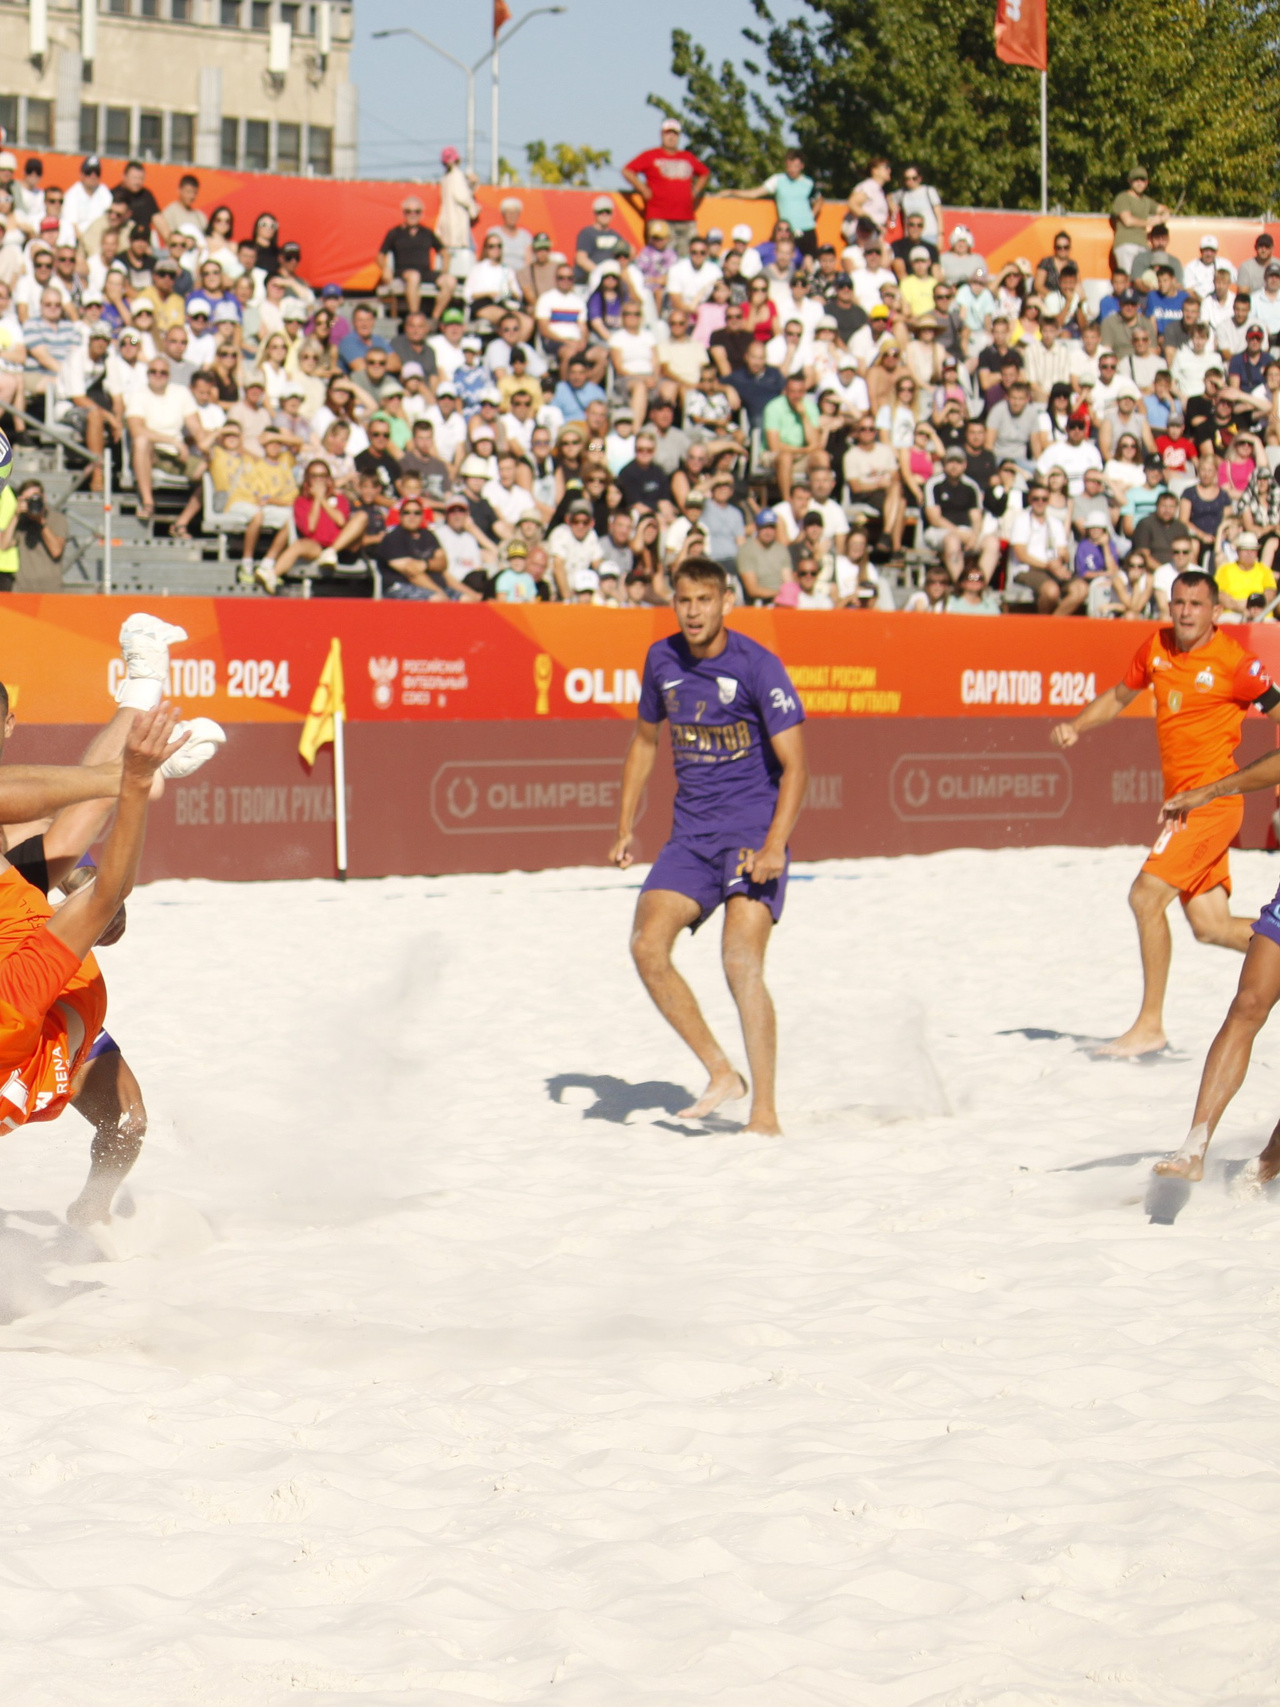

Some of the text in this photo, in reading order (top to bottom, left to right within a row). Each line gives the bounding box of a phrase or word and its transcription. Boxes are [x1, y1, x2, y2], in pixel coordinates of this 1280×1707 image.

[227, 660, 291, 698] 2024
[961, 669, 1096, 705] САРАТОВ 2024
[176, 781, 210, 826] ВСЁ
[214, 787, 227, 825] В
[231, 785, 288, 824] ТВОИХ
[937, 774, 1060, 800] OLIMPBET
